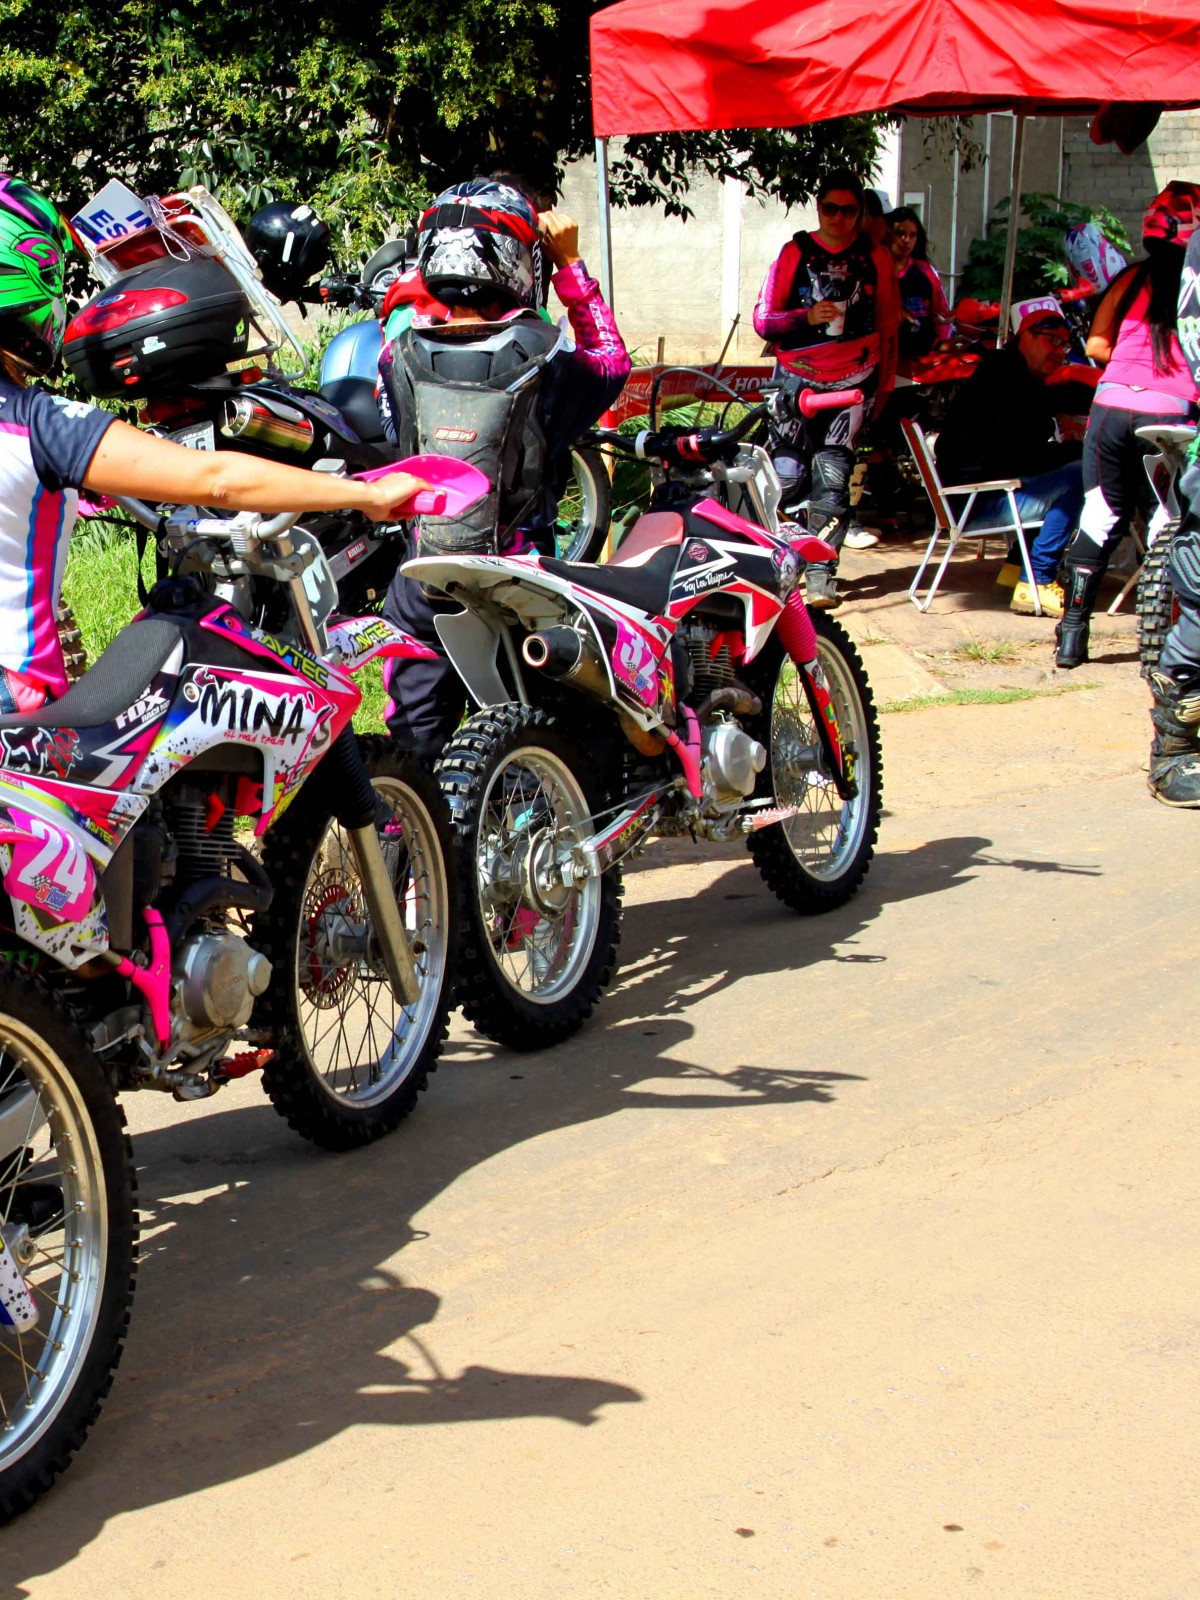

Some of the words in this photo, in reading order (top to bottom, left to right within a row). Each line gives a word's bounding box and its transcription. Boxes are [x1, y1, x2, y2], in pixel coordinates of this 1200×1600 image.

[735, 377, 772, 392] HON
[355, 620, 393, 655] AVTEC
[259, 634, 328, 688] AVTEC
[115, 687, 167, 730] FOX
[201, 688, 331, 750] MINA'S
[261, 734, 285, 746] team
[17, 819, 88, 904] 24
